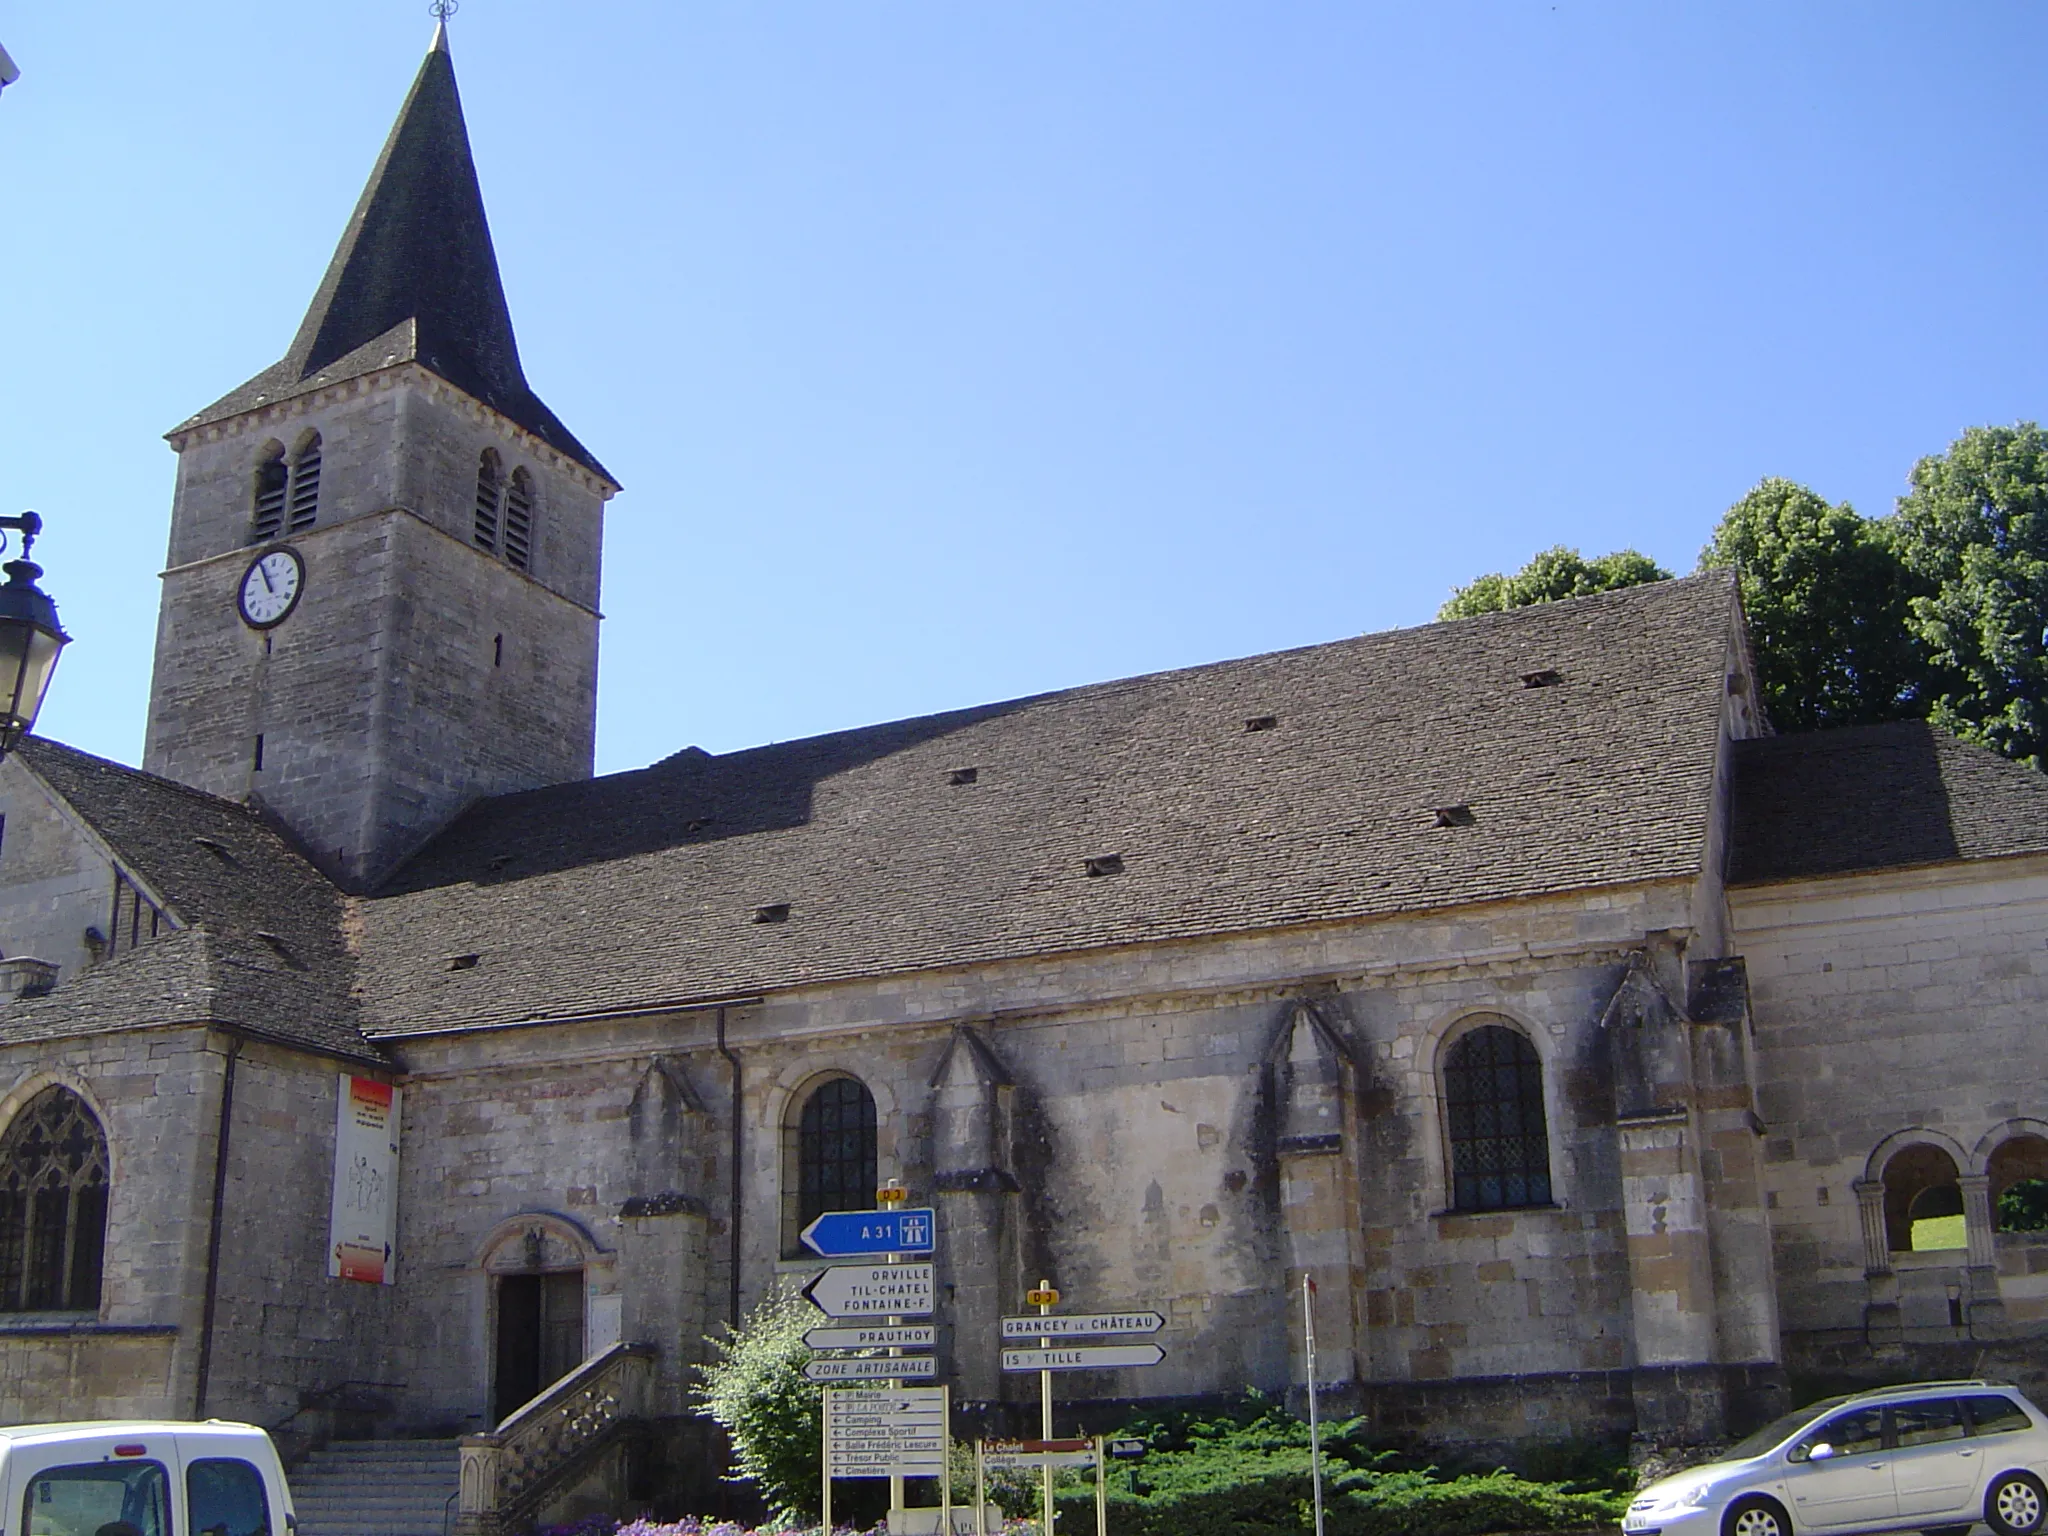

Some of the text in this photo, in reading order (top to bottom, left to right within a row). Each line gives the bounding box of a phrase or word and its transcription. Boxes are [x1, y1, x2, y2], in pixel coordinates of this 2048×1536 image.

[883, 1189, 901, 1199] D 3
[861, 1225, 891, 1239] A 31
[872, 1268, 929, 1281] ORVILLE
[851, 1284, 929, 1296] TIL-CHATEL
[1033, 1293, 1052, 1302] D 3
[844, 1298, 930, 1311] FONTAINE-F.
[1006, 1320, 1068, 1332] GRANCEY
[1091, 1316, 1153, 1330] CHÂTEAU
[859, 1329, 930, 1342] PRAUTHOY
[1006, 1354, 1019, 1365] IS
[1045, 1352, 1082, 1364] TILLE
[815, 1361, 931, 1375] ZONE ARTISANALE
[845, 1416, 882, 1426] Camping
[845, 1427, 917, 1438] Complexe Sportif
[845, 1440, 938, 1449] Salle Frédéric Lescure
[983, 1442, 1024, 1452] Le Chalet
[845, 1453, 899, 1462] Trésor Public
[984, 1455, 1017, 1465] Collège
[845, 1467, 886, 1475] Cimetière
